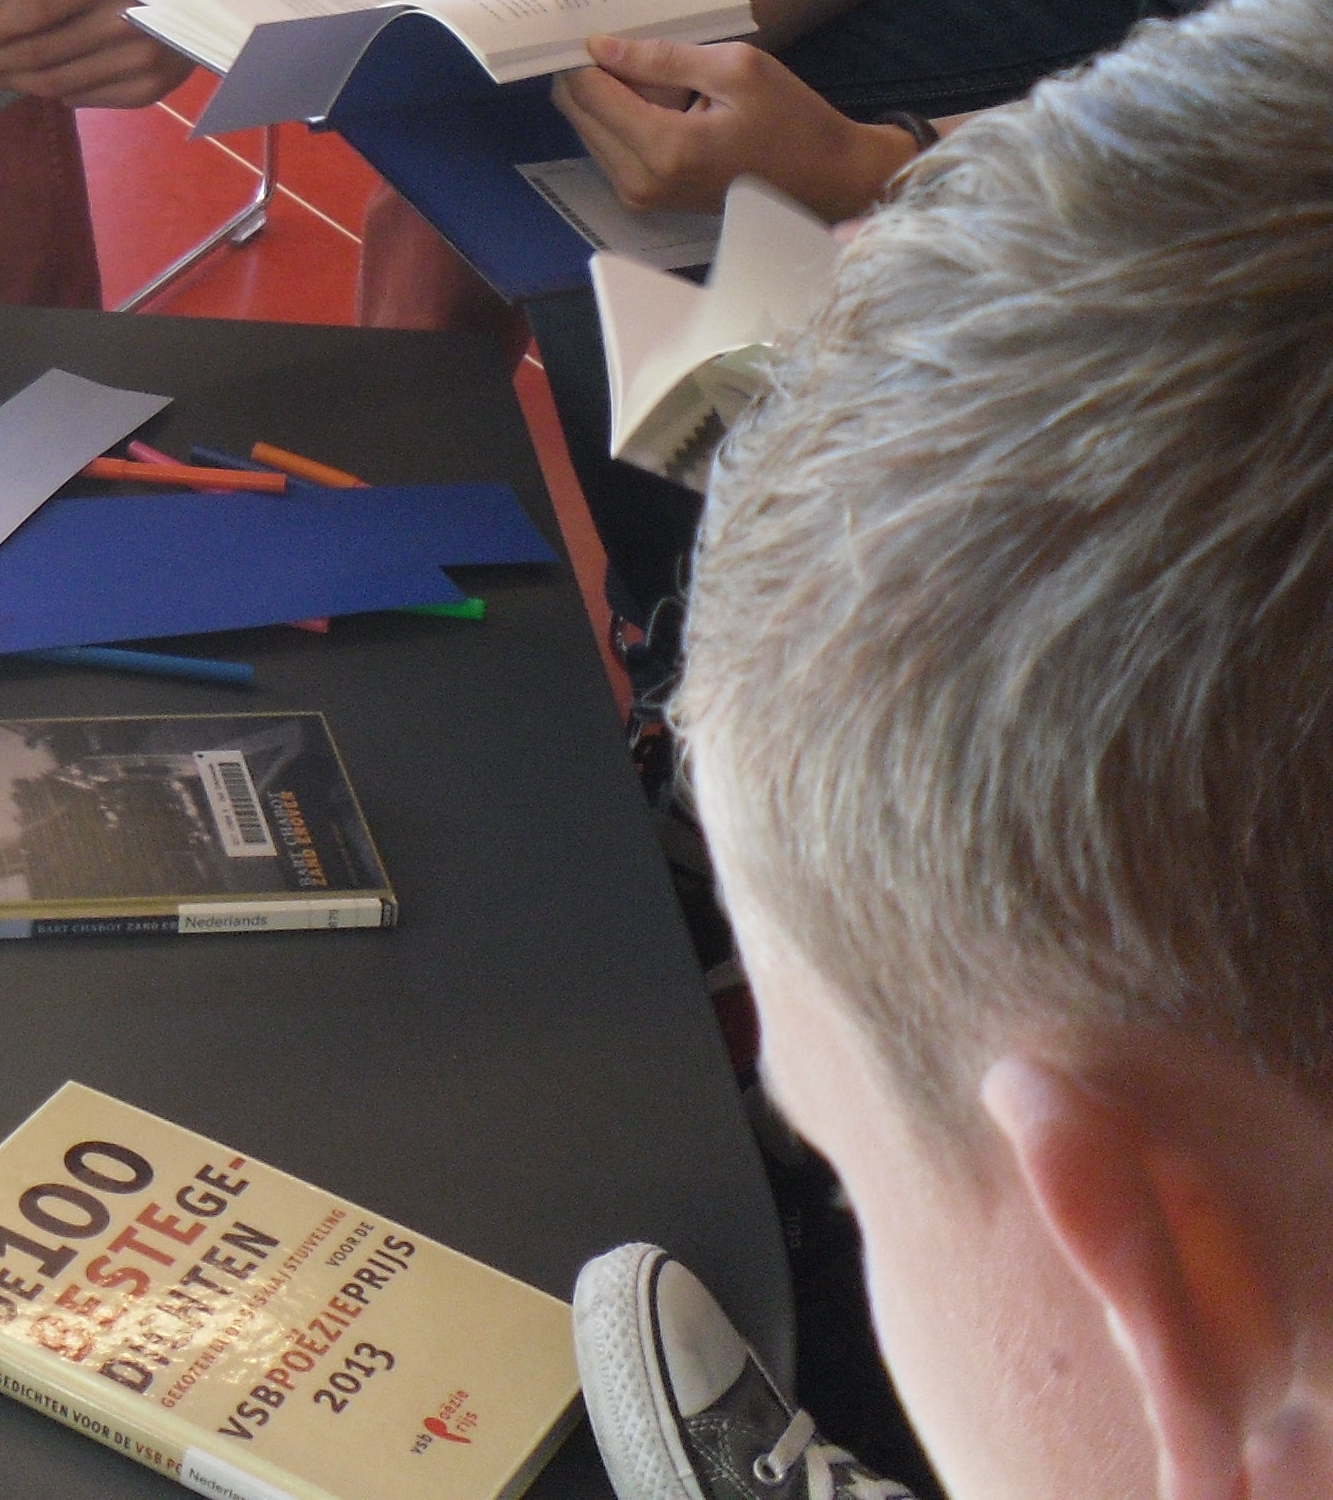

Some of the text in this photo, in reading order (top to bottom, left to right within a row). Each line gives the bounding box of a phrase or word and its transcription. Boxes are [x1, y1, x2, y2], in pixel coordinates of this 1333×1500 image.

[185, 913, 268, 931] Nederlands
[285, 1208, 346, 1273] STUIVELING
[325, 1220, 375, 1269] VOOR DE
[313, 1340, 396, 1414] 2013
[71, 1409, 111, 1440] VOOR
[113, 1430, 132, 1450] DE
[134, 1442, 164, 1466] VSB
